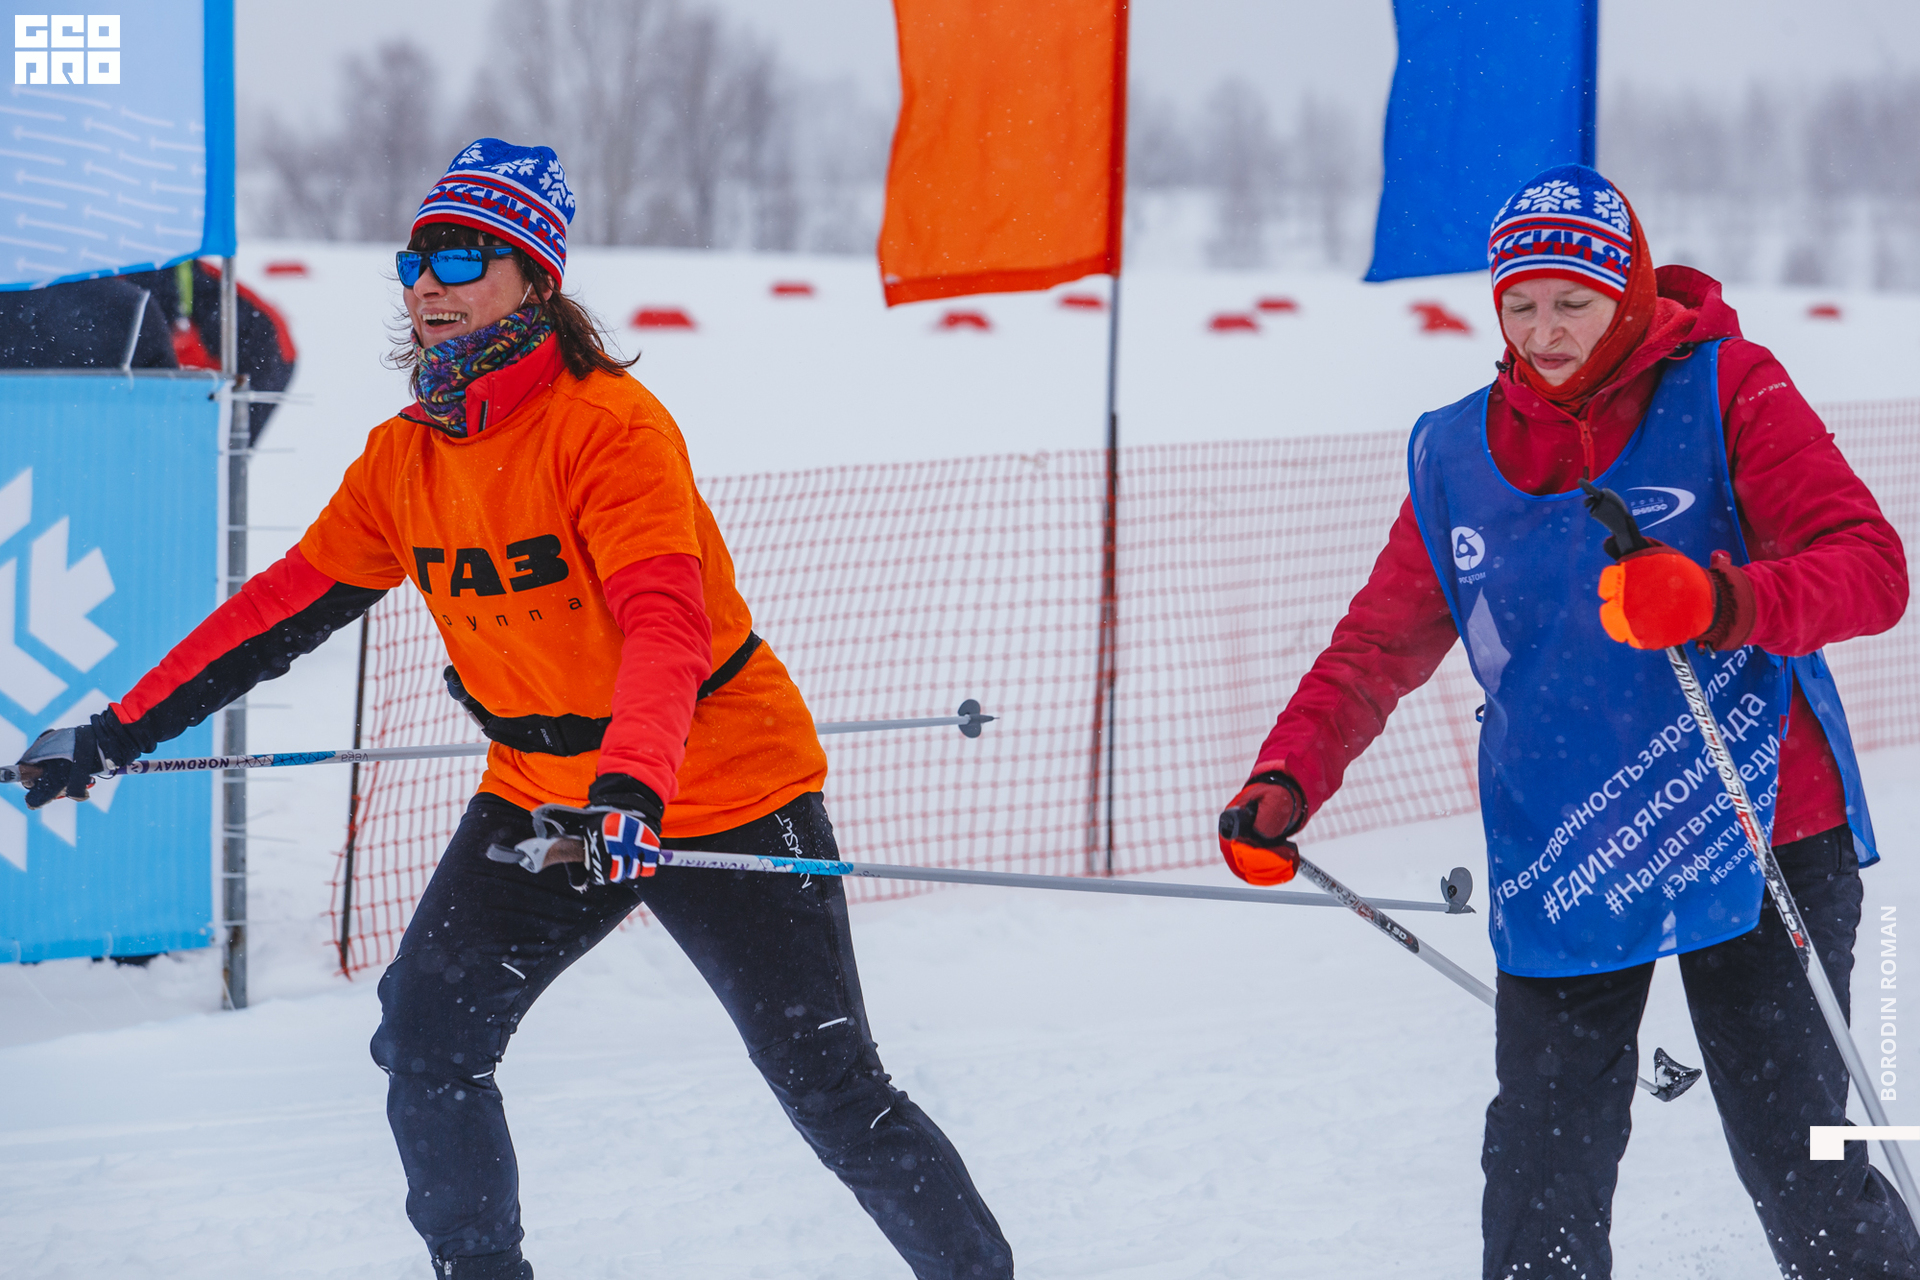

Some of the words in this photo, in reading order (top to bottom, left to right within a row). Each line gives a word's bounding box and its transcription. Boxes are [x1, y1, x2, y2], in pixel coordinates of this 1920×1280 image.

[412, 533, 570, 598] ГАЗ
[153, 757, 230, 773] NORDWAY
[1603, 734, 1781, 916] #Нашагвпееди
